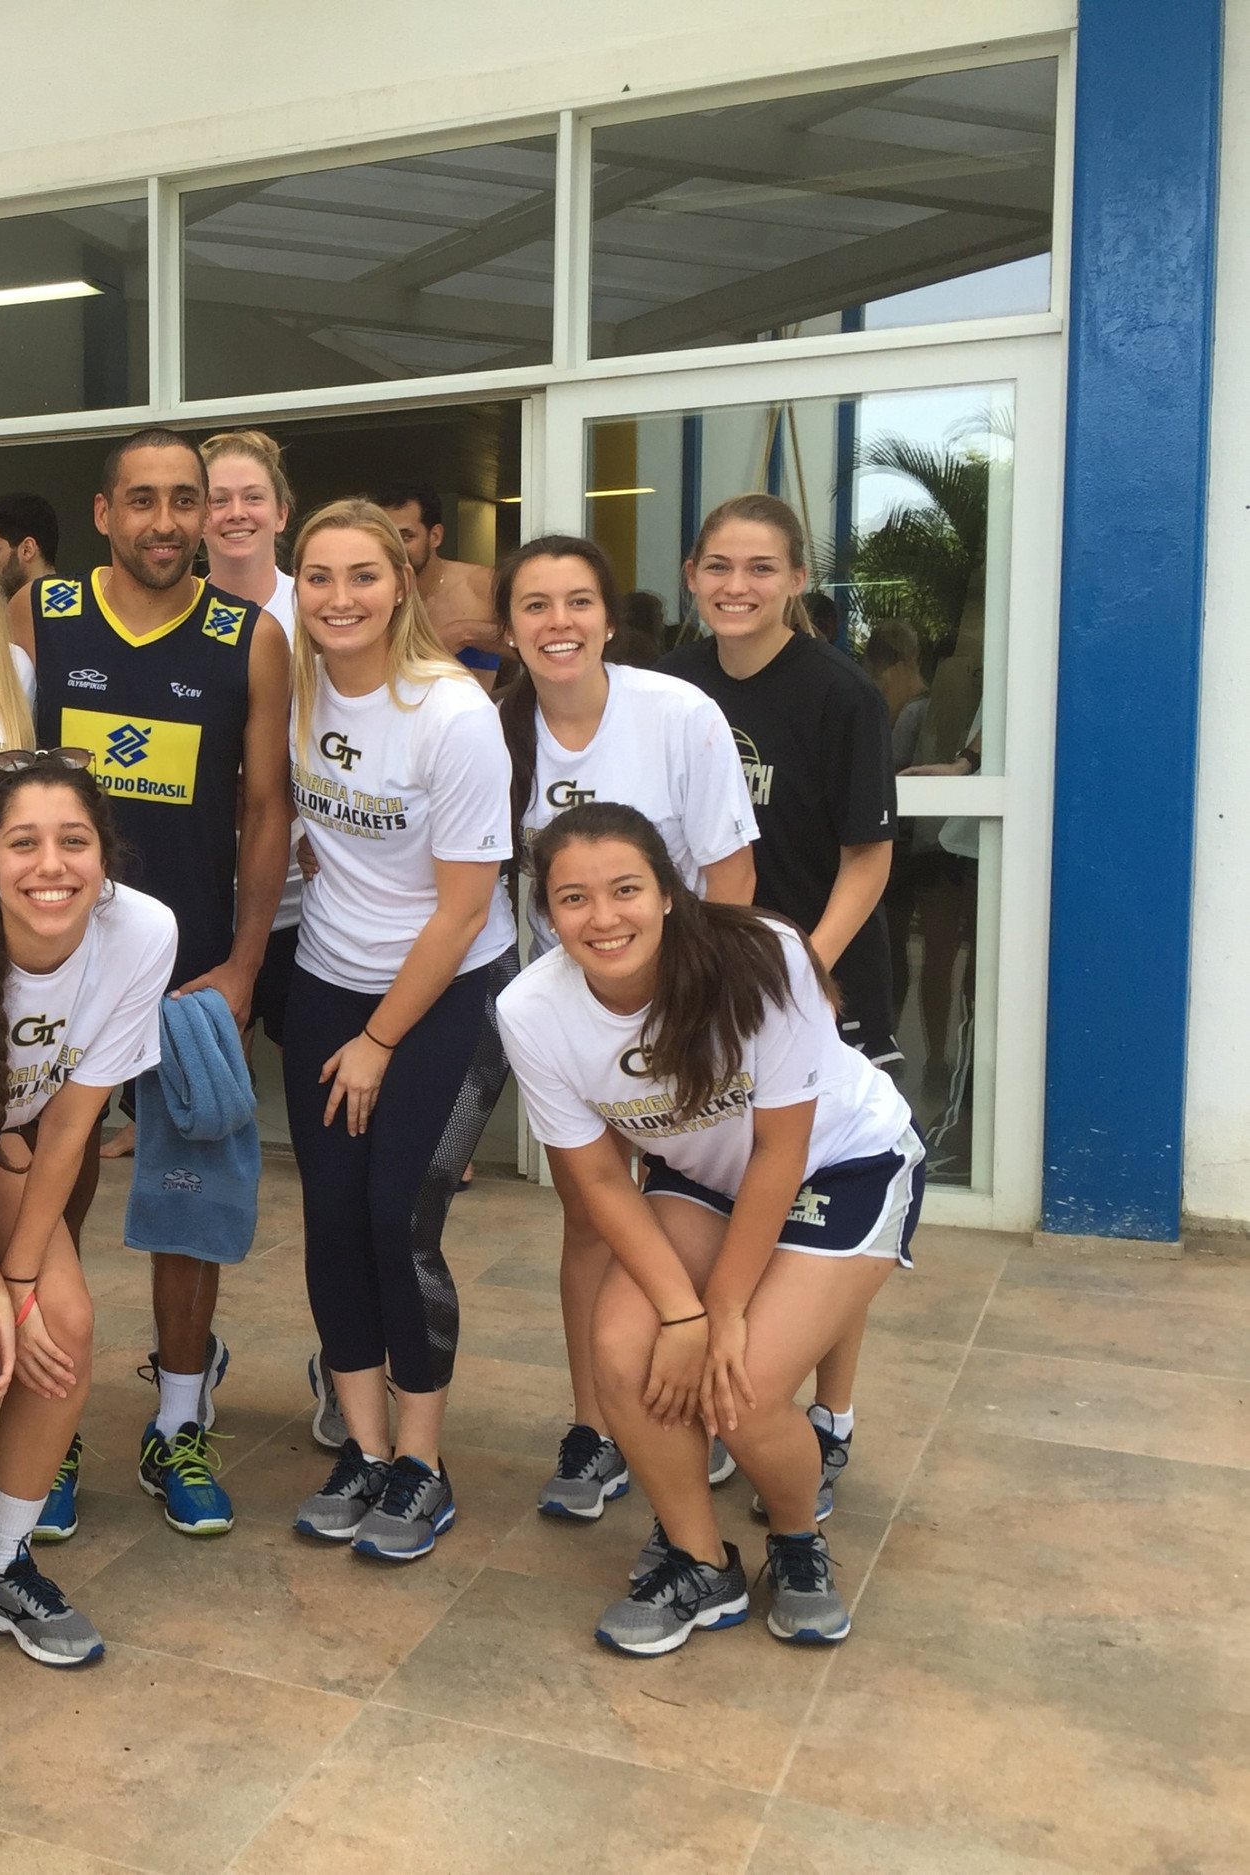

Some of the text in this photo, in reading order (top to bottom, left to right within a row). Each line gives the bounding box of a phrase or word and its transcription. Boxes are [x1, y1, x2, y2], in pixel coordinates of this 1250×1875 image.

[185, 687, 202, 698] CBV
[319, 731, 362, 771] GT
[114, 777, 134, 792] DO
[137, 777, 187, 798] BRASIL
[353, 790, 403, 815] TECH
[333, 803, 407, 831] JACKETS
[11, 1014, 66, 1047] GT
